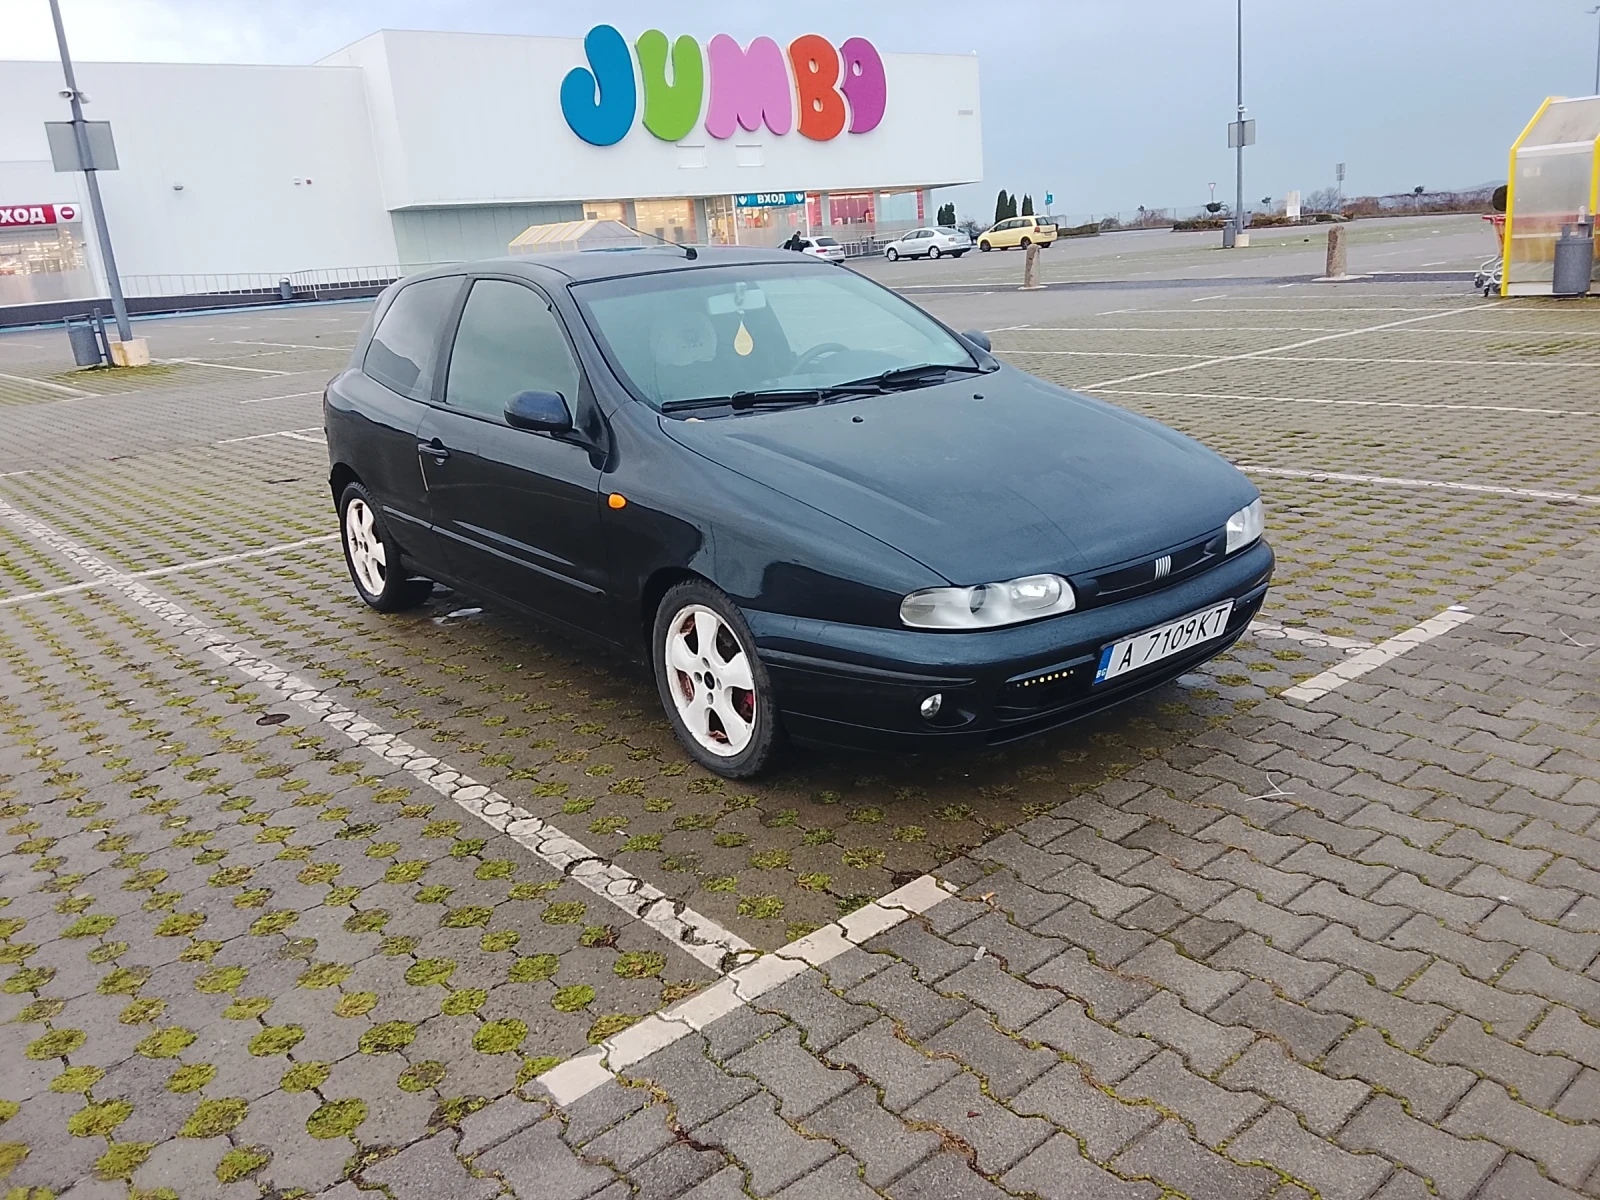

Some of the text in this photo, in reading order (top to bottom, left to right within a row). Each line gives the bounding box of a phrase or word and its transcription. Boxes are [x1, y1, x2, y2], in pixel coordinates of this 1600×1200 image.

[559, 24, 887, 147] JUMBO
[757, 193, 786, 205] ВХОД
[1118, 642, 1133, 671] A
[1095, 667, 1107, 679] BG
